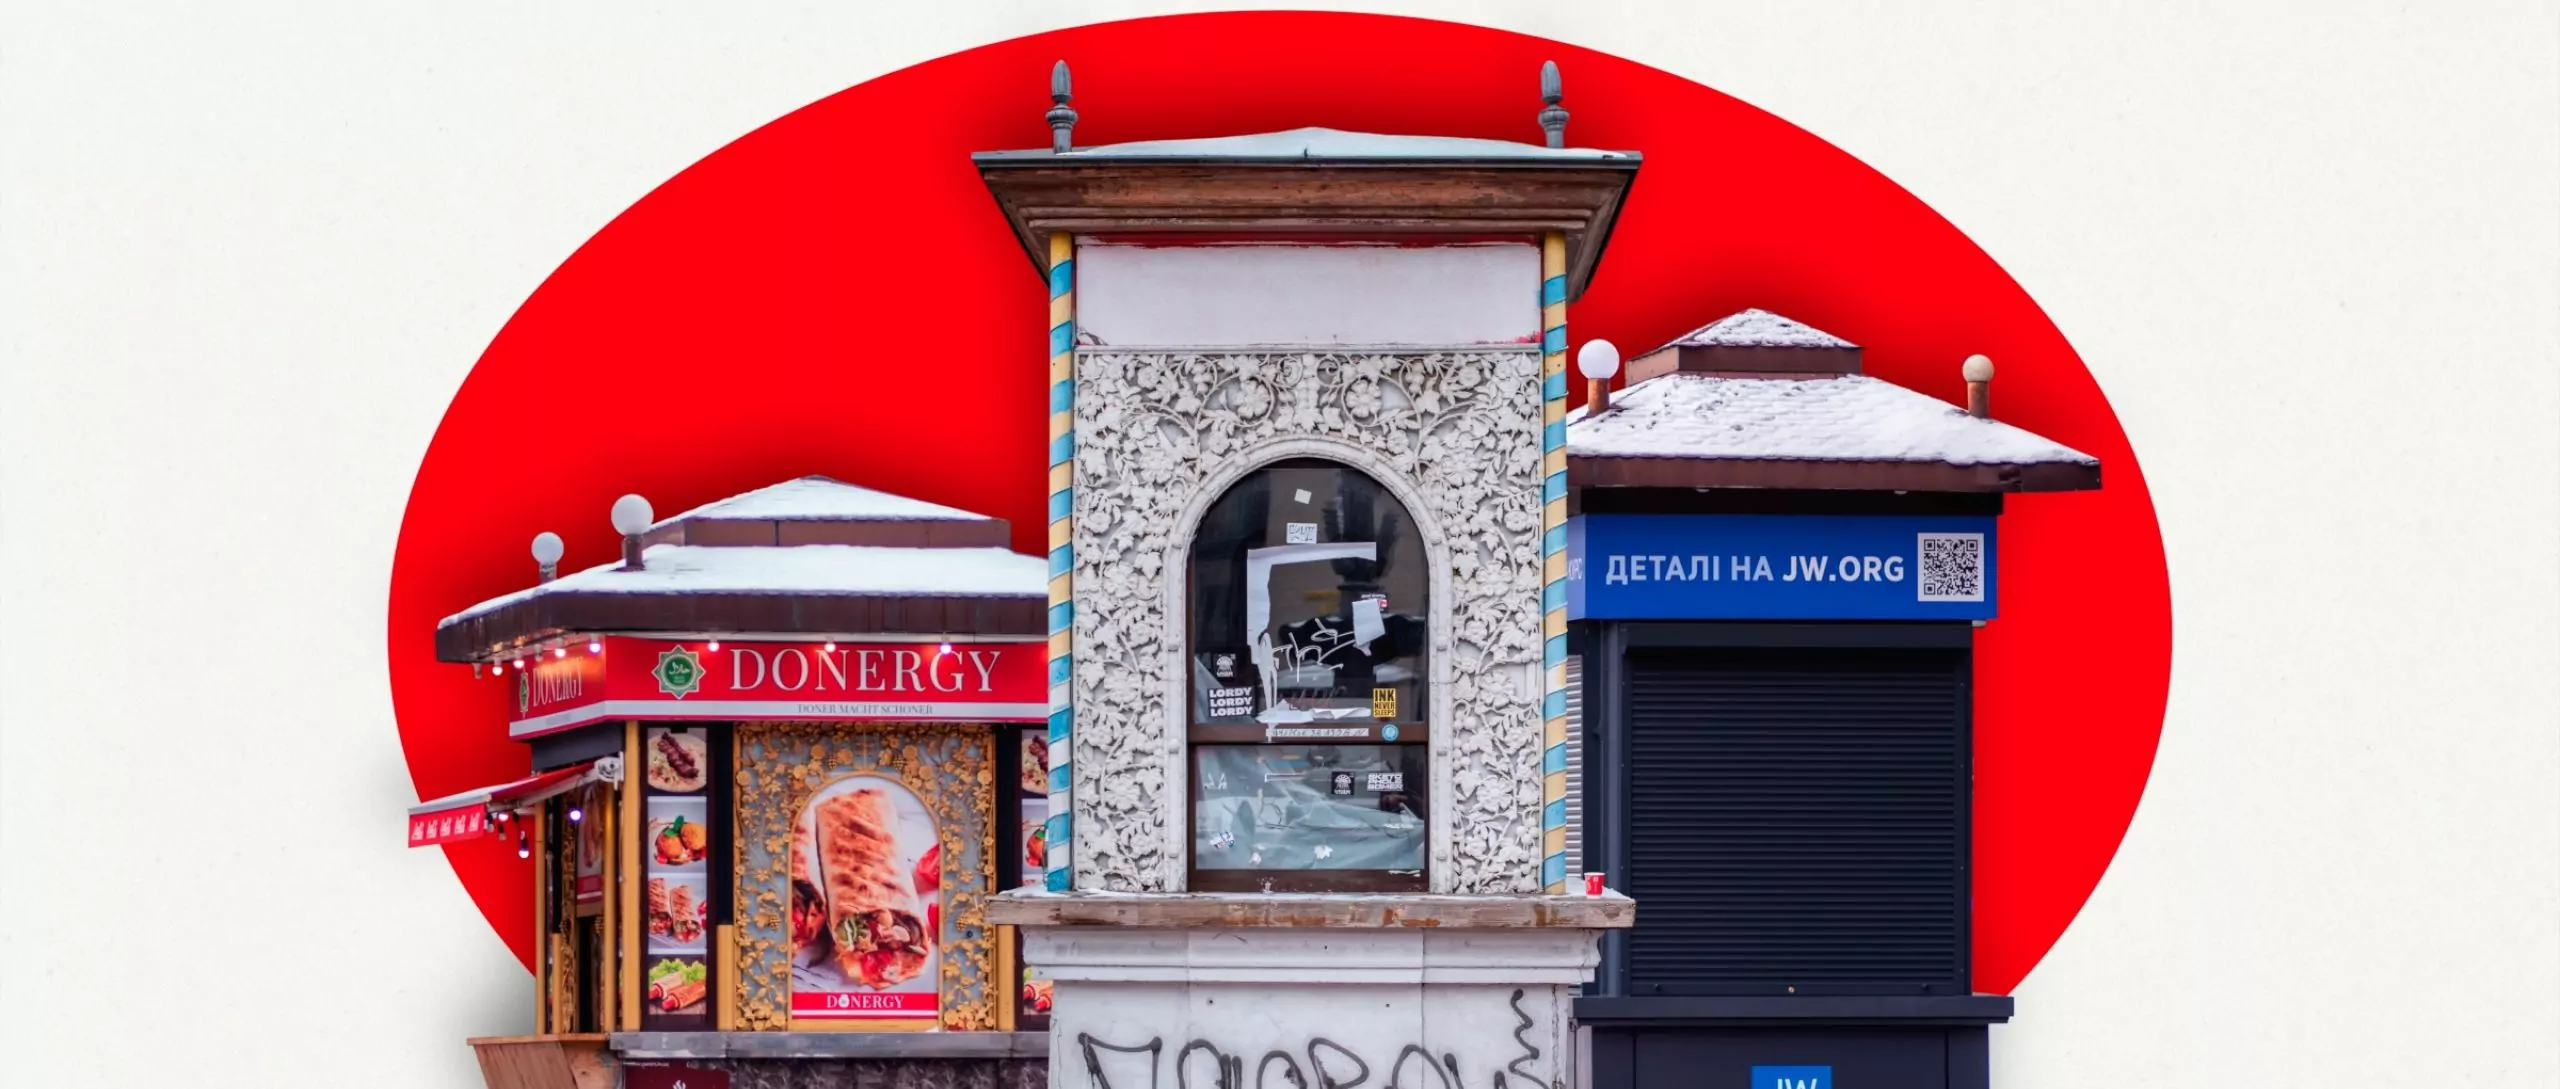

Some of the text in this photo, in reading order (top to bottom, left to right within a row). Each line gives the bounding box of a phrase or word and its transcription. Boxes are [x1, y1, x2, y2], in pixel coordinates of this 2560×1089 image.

[1605, 555, 1904, 585] ДЕТАЛІ НА JW.ORG
[729, 647, 1001, 692] DONERGY
[533, 656, 584, 707] DONERGY
[1209, 687, 1252, 698] LORDY
[1374, 690, 1394, 701] INK
[1210, 697, 1253, 707] LORDY
[1374, 702, 1394, 710] NEVER
[839, 703, 878, 714] MACHT
[1210, 706, 1253, 717] LORDY
[826, 994, 905, 1009] DONERGY
